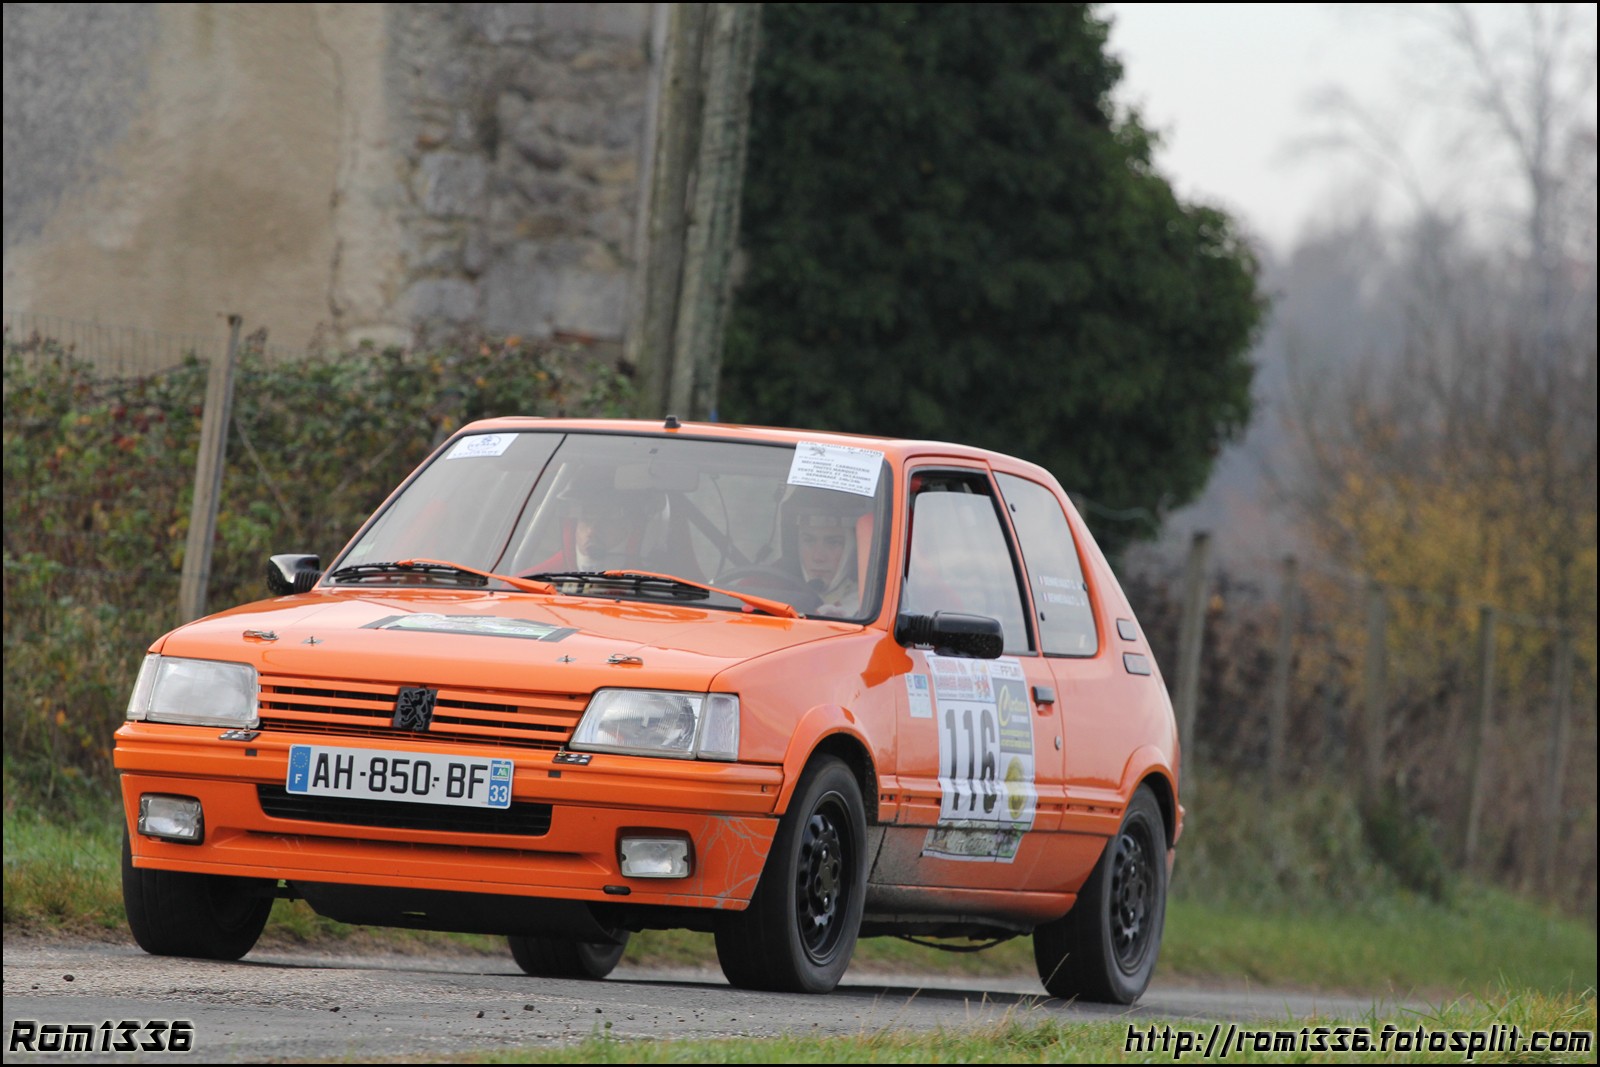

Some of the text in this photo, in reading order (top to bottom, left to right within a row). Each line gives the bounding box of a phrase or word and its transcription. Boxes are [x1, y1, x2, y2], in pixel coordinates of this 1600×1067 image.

[859, 448, 883, 457] AUTOS
[945, 709, 997, 814] 116
[295, 773, 302, 785] F
[489, 784, 509, 803] 33
